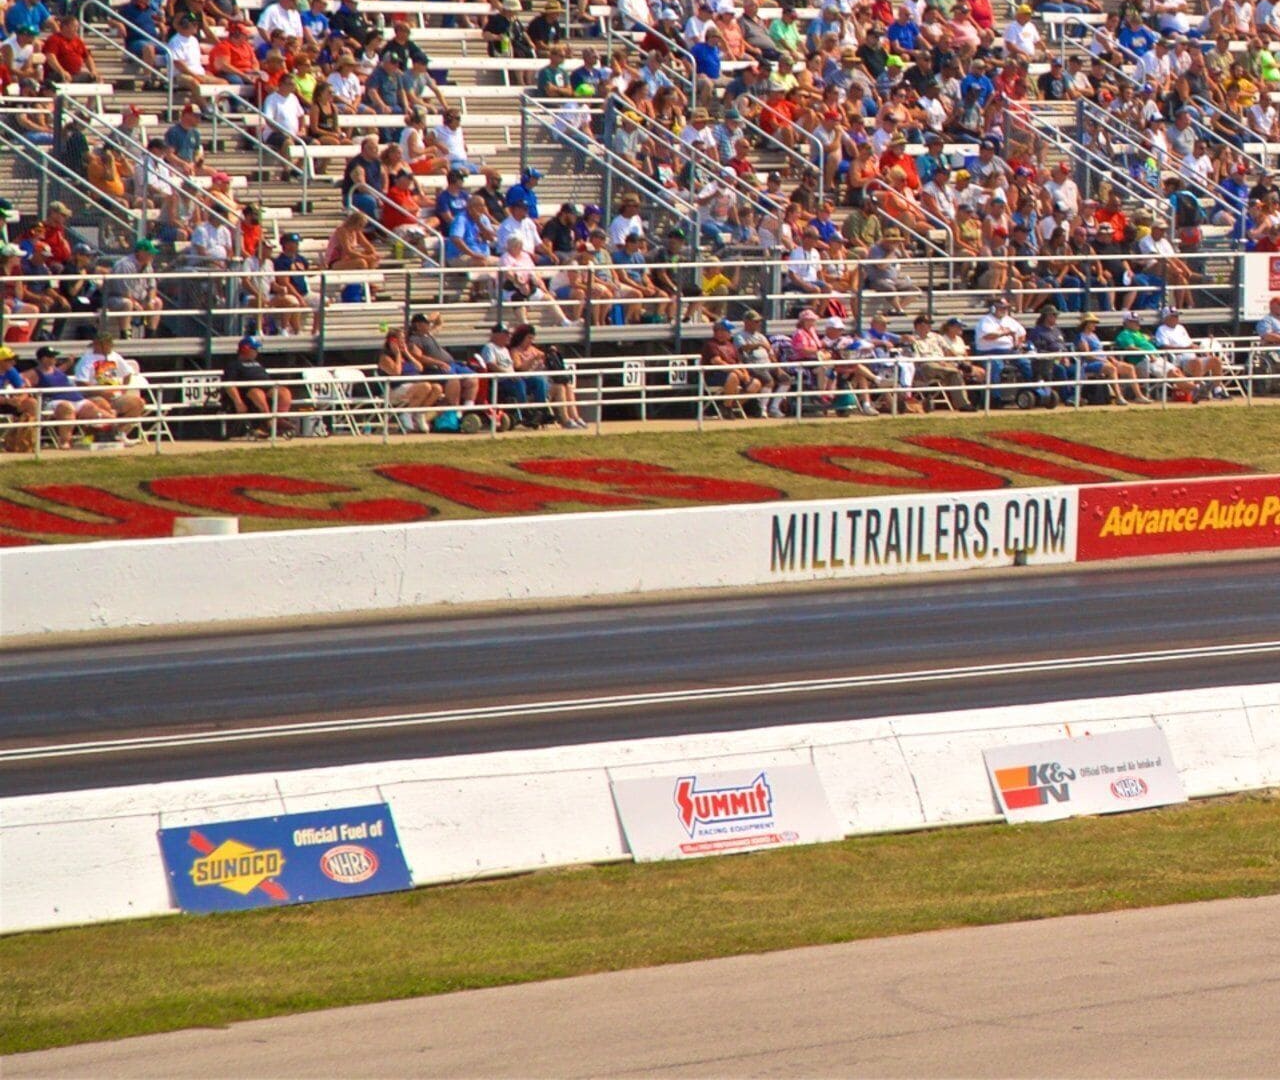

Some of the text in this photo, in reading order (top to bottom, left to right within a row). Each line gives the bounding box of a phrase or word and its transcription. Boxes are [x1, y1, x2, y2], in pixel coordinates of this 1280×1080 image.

[1100, 505, 1198, 537] Advance
[1199, 500, 1259, 531] Auto
[769, 496, 1069, 573] MILLTRAILERS.COM
[1080, 767, 1100, 778] Official
[293, 819, 383, 847] Official Fuel of
[698, 822, 775, 836] RACING EQUIPMENT
[196, 852, 279, 883] SUNOCO
[327, 851, 371, 878] NHRA
